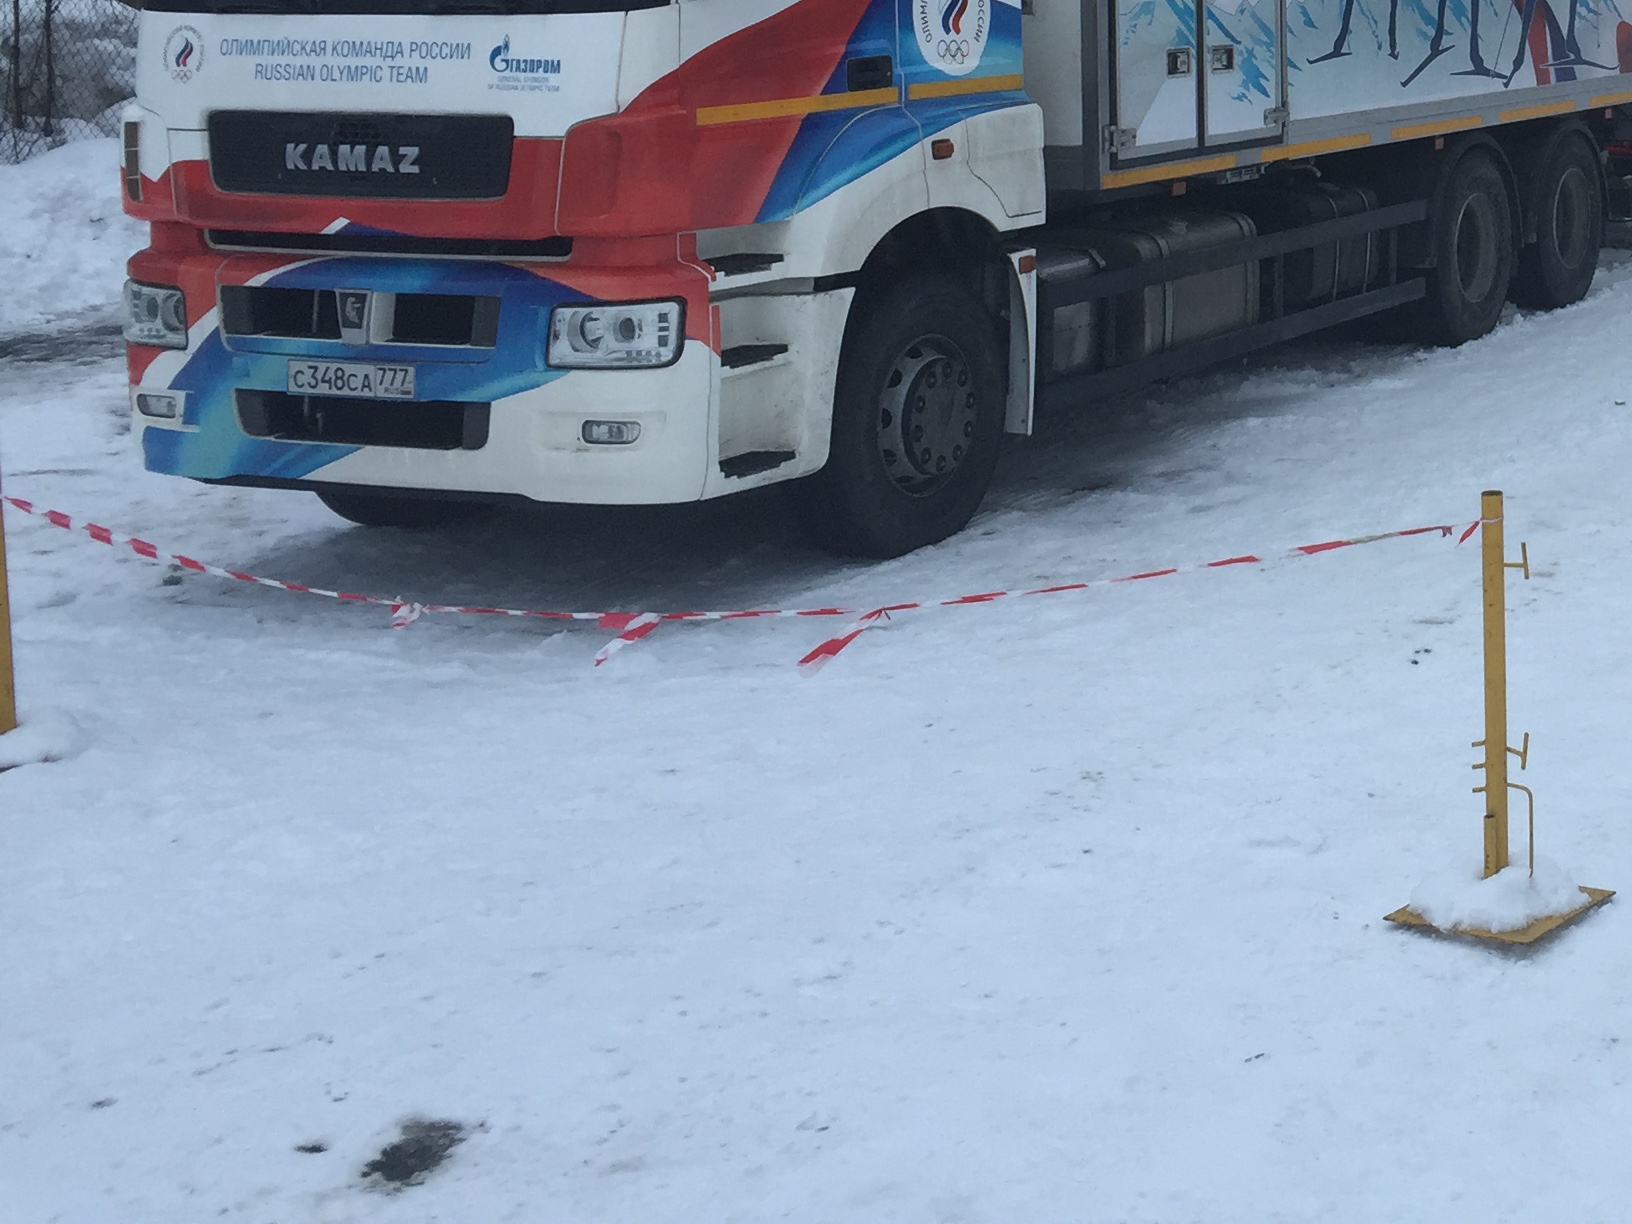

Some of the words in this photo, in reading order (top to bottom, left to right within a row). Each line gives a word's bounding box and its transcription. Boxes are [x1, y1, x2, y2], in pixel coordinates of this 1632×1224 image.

[219, 37, 327, 58] ОЛИМПИЙСКАЯ
[331, 40, 404, 62] КОМАНДА
[409, 41, 471, 60] РОССИИ
[254, 63, 316, 81] RUSSIAN
[319, 64, 383, 83] OLYMPIC
[387, 65, 429, 84] TEAM
[285, 143, 420, 174] KAMAZ
[377, 367, 409, 387] 777
[384, 386, 400, 394] RUS
